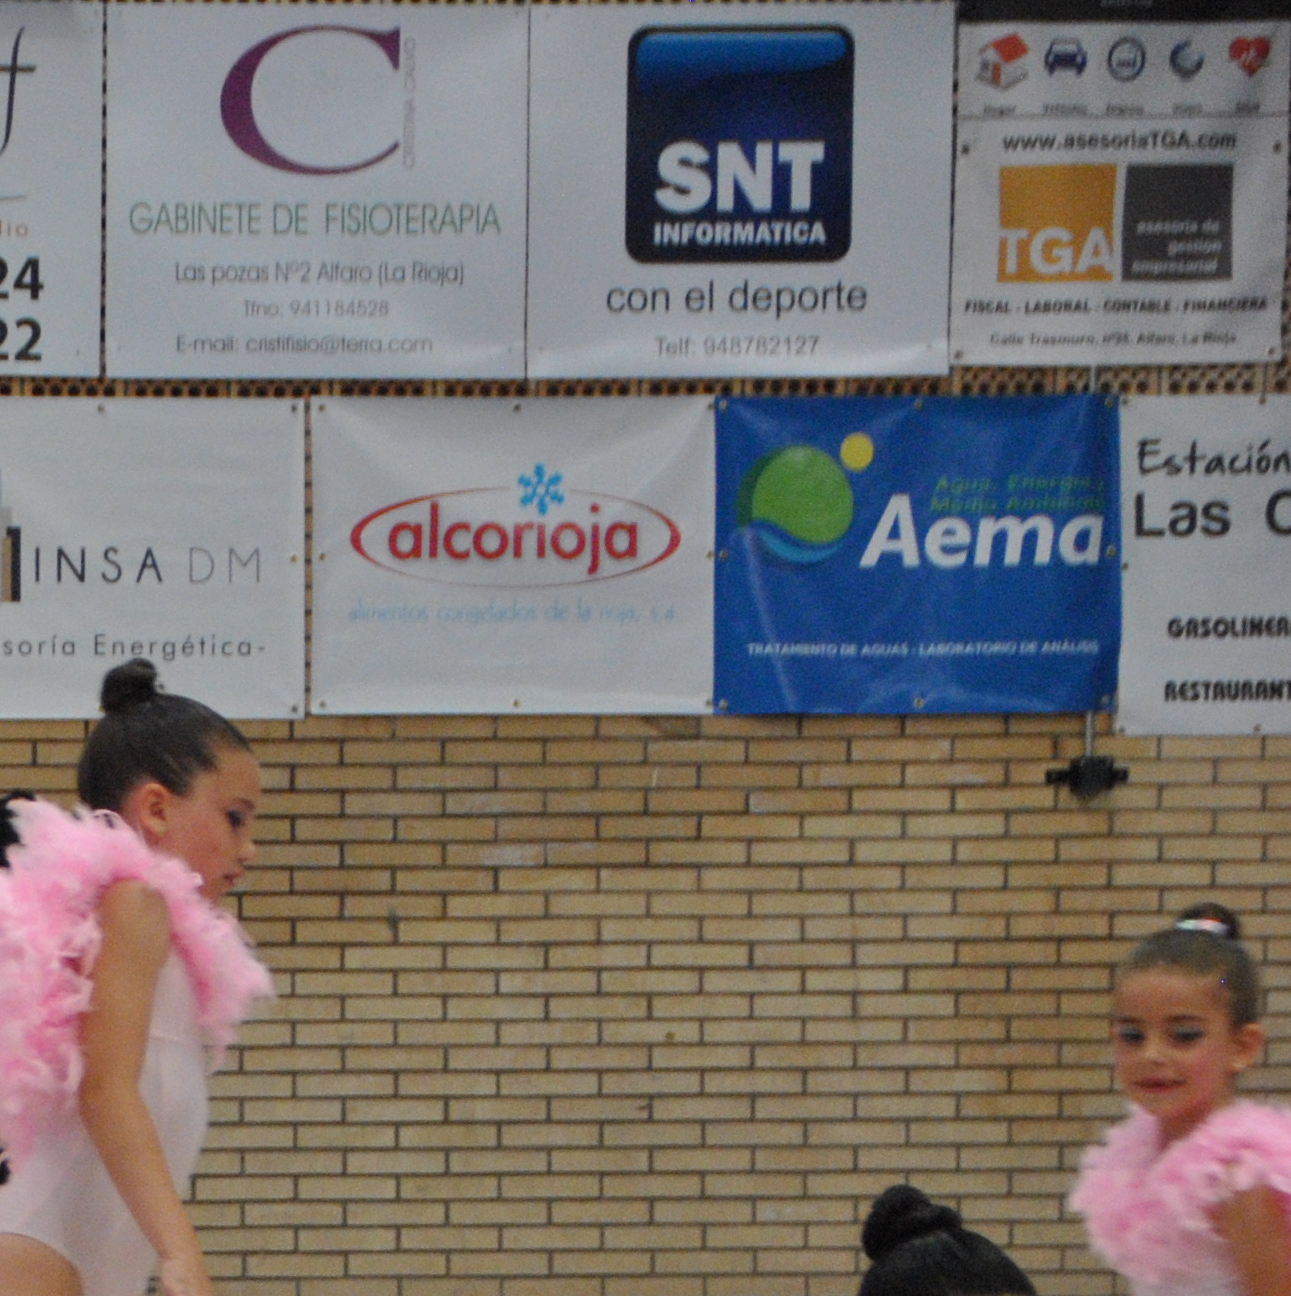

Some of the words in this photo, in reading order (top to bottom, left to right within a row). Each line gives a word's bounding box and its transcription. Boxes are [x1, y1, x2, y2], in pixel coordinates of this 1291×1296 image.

[654, 139, 824, 213] SNT
[128, 202, 260, 235] GABINETE
[273, 202, 308, 236] DE
[325, 202, 501, 236] FISIOTERAPIA
[654, 221, 825, 246] INFORMATICA
[998, 226, 1114, 275] TGA
[175, 262, 205, 282] Las
[212, 266, 269, 286] pozas
[319, 261, 372, 282] Alfaro
[606, 288, 669, 314] con
[685, 279, 715, 314] el
[728, 279, 868, 320] deporte
[1138, 438, 1291, 475] Estación
[859, 493, 1105, 569] Aema
[1135, 490, 1231, 537] Las
[388, 501, 637, 575] alcorioja
[34, 546, 163, 584] INSA
[188, 546, 261, 584] DM
[1168, 616, 1291, 639] GASOLINER
